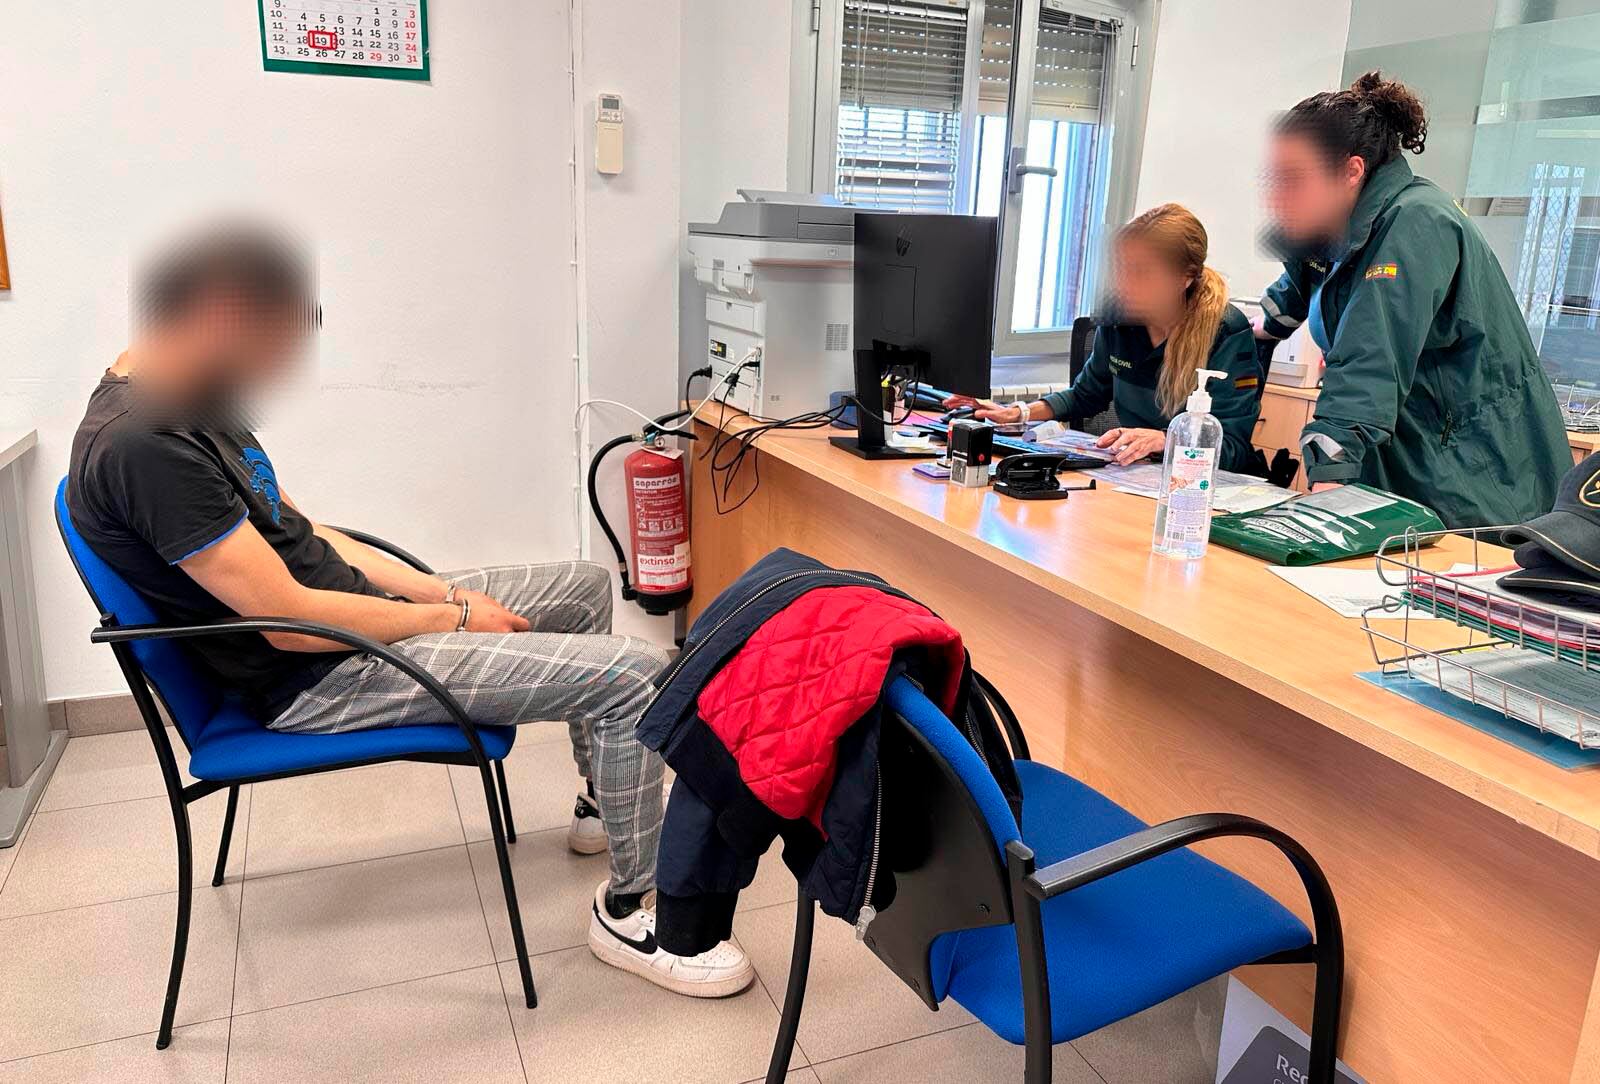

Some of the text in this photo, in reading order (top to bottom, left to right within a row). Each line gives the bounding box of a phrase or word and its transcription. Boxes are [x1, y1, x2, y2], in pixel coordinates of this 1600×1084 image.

[300, 12, 307, 21] 4
[319, 13, 326, 23] 5
[337, 15, 344, 24] 6
[356, 16, 362, 26] 7
[373, 18, 381, 27] 8
[391, 19, 398, 28] 9
[374, 7, 380, 15] 1
[409, 10, 416, 19] 3
[296, 23, 308, 31] 11
[333, 26, 345, 36] 13
[351, 28, 363, 37] 14
[369, 29, 381, 38] 15
[387, 31, 399, 40] 16
[405, 32, 417, 41] 17
[296, 35, 308, 44] 18
[315, 36, 327, 46] 19
[352, 39, 364, 48] 21
[369, 41, 382, 49] 22
[387, 42, 400, 51] 23
[404, 43, 417, 52] 24
[297, 47, 310, 57] 25
[315, 49, 328, 58] 26
[334, 49, 346, 59] 27
[352, 51, 365, 60] 28
[369, 52, 382, 62] 29
[387, 53, 400, 63] 30
[406, 55, 418, 64] 31
